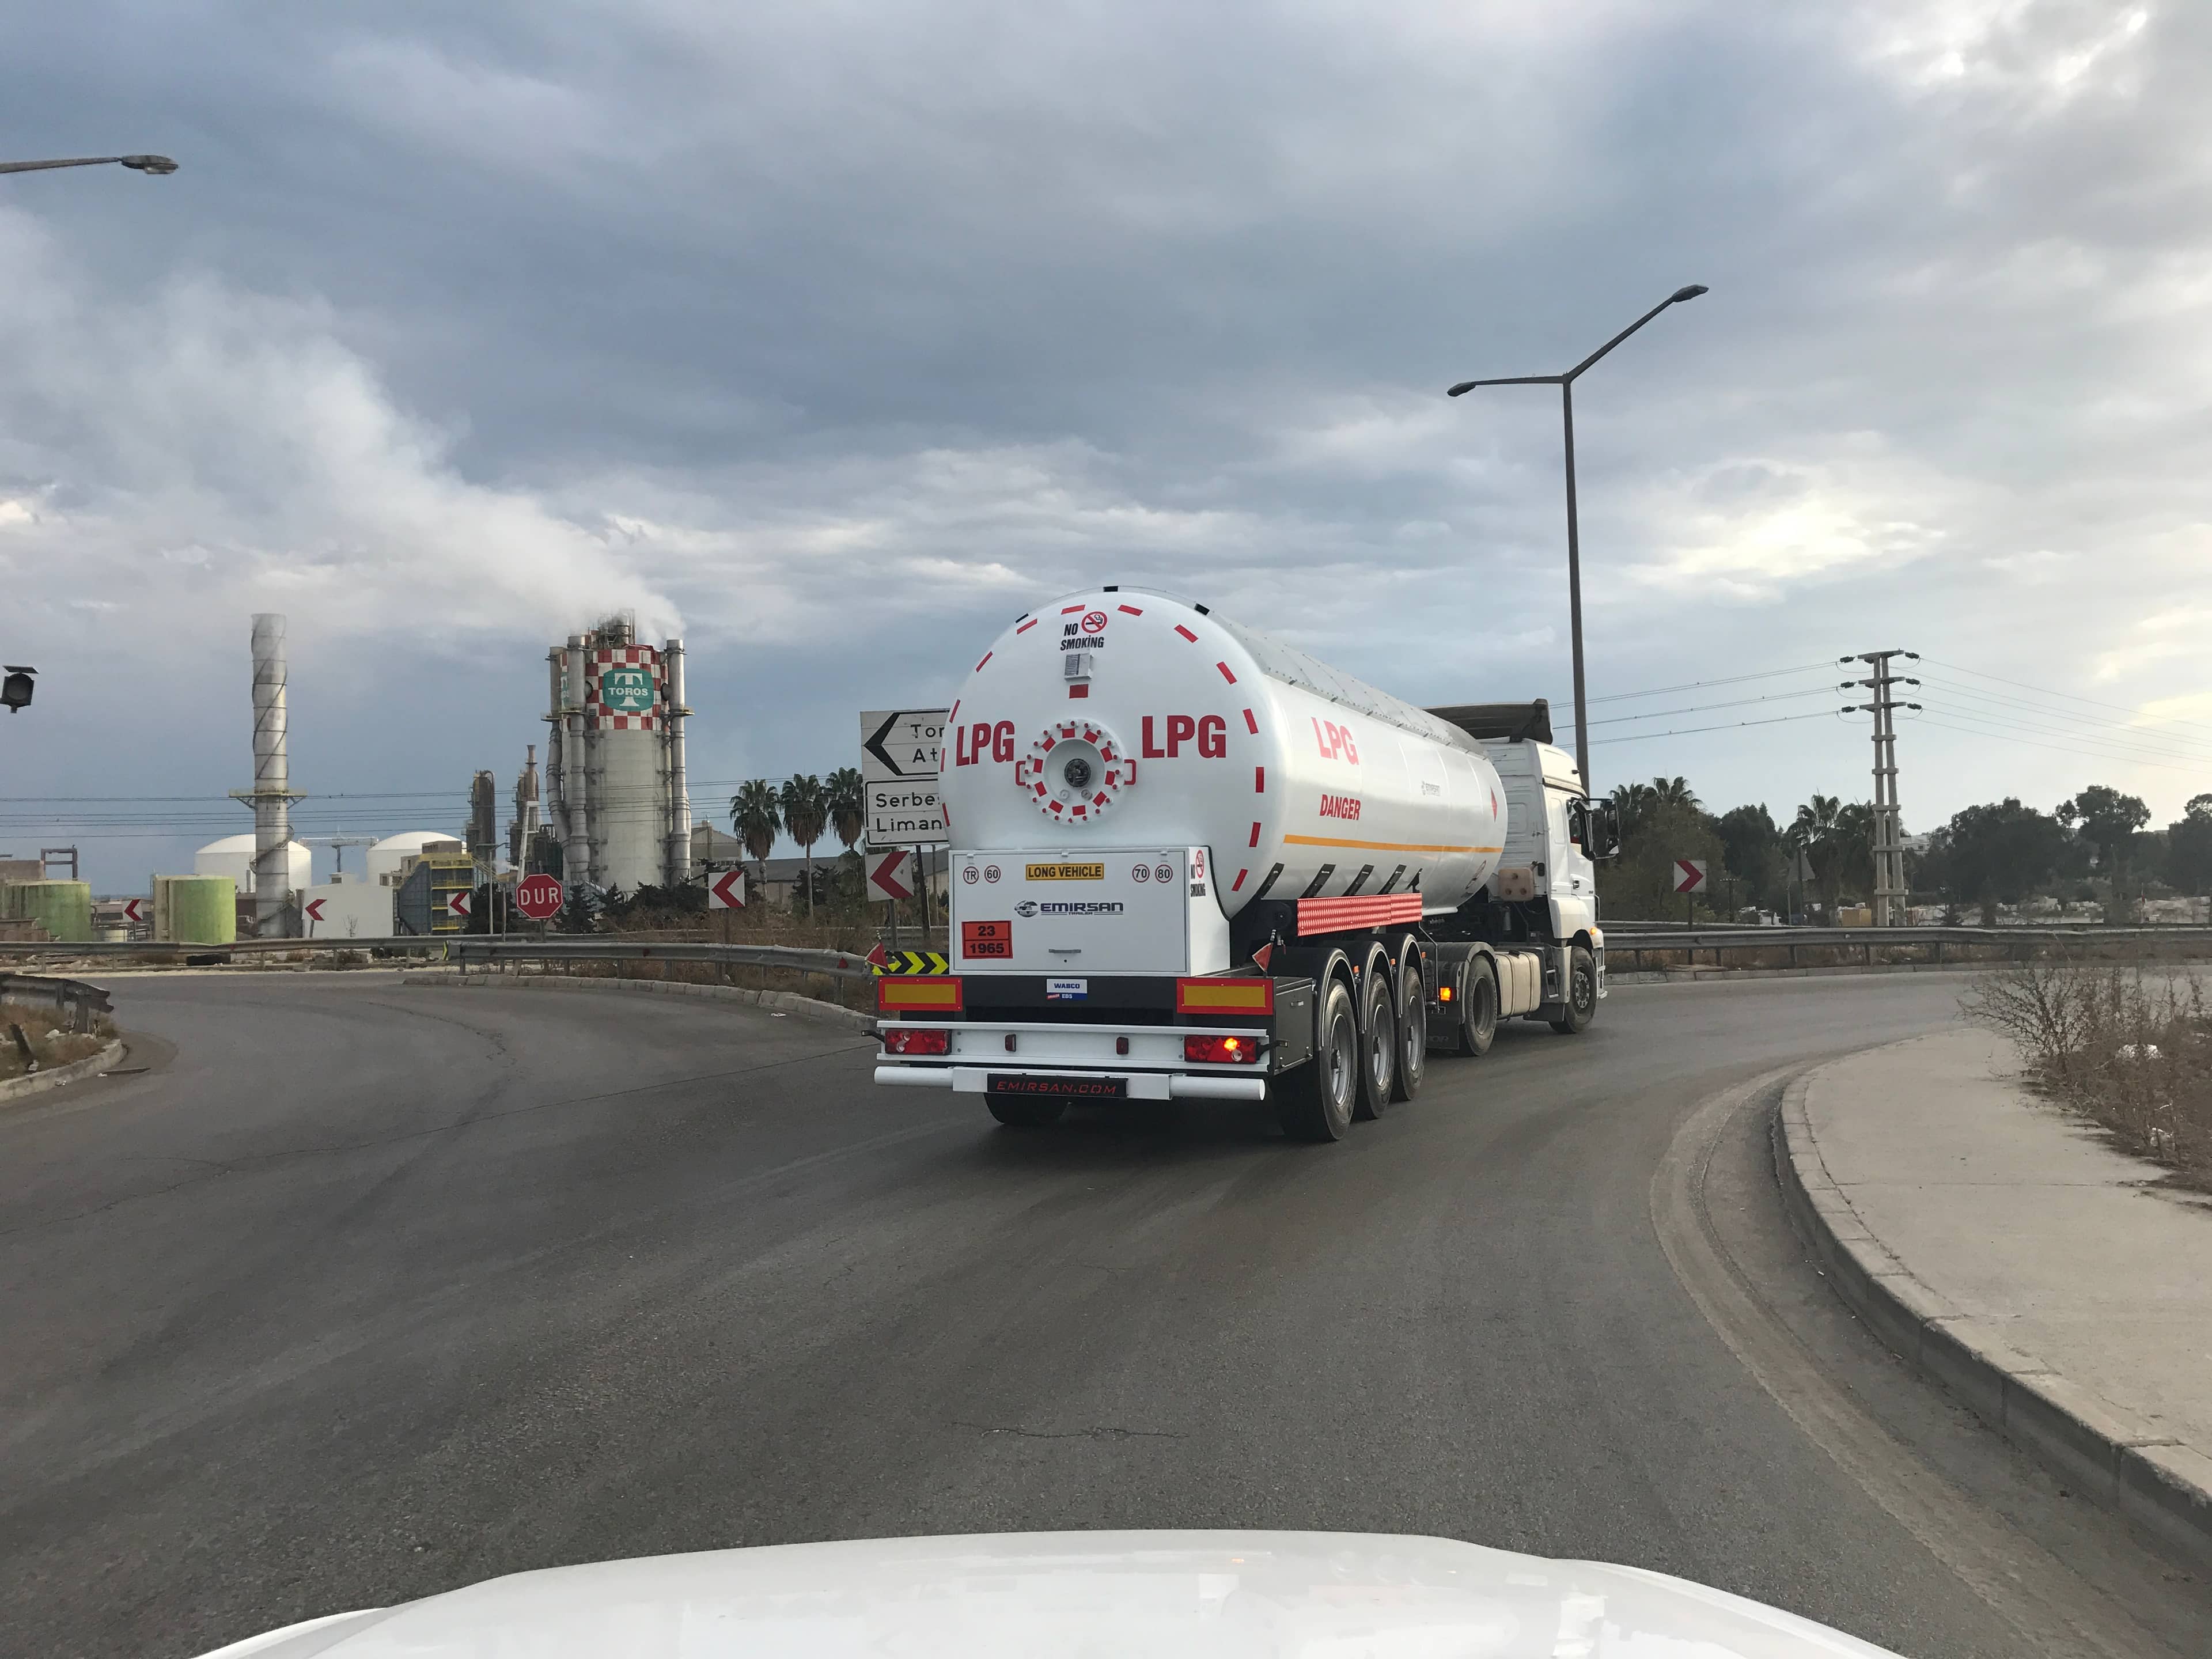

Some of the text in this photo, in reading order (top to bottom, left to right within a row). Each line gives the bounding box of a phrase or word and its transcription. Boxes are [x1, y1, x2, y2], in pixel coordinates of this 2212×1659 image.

[1064, 623, 1078, 636] NO
[608, 687, 648, 696] TOROS
[1142, 714, 1226, 758] LPG
[1310, 717, 1359, 765] LPG
[956, 721, 1014, 766] LPG
[1319, 794, 1361, 820] DANGER
[876, 818, 942, 832] Liman
[965, 870, 976, 880] TR
[987, 869, 998, 879] 60
[1028, 865, 1102, 878] LONG VEHICLE
[1135, 869, 1147, 878] 70
[1158, 869, 1171, 878] 80
[520, 887, 559, 906] DUR
[1040, 903, 1123, 912] EMIRSAN
[978, 925, 995, 936] 23
[969, 943, 1005, 954] 1965
[997, 1081, 1116, 1094] EMIRSAN.COM
